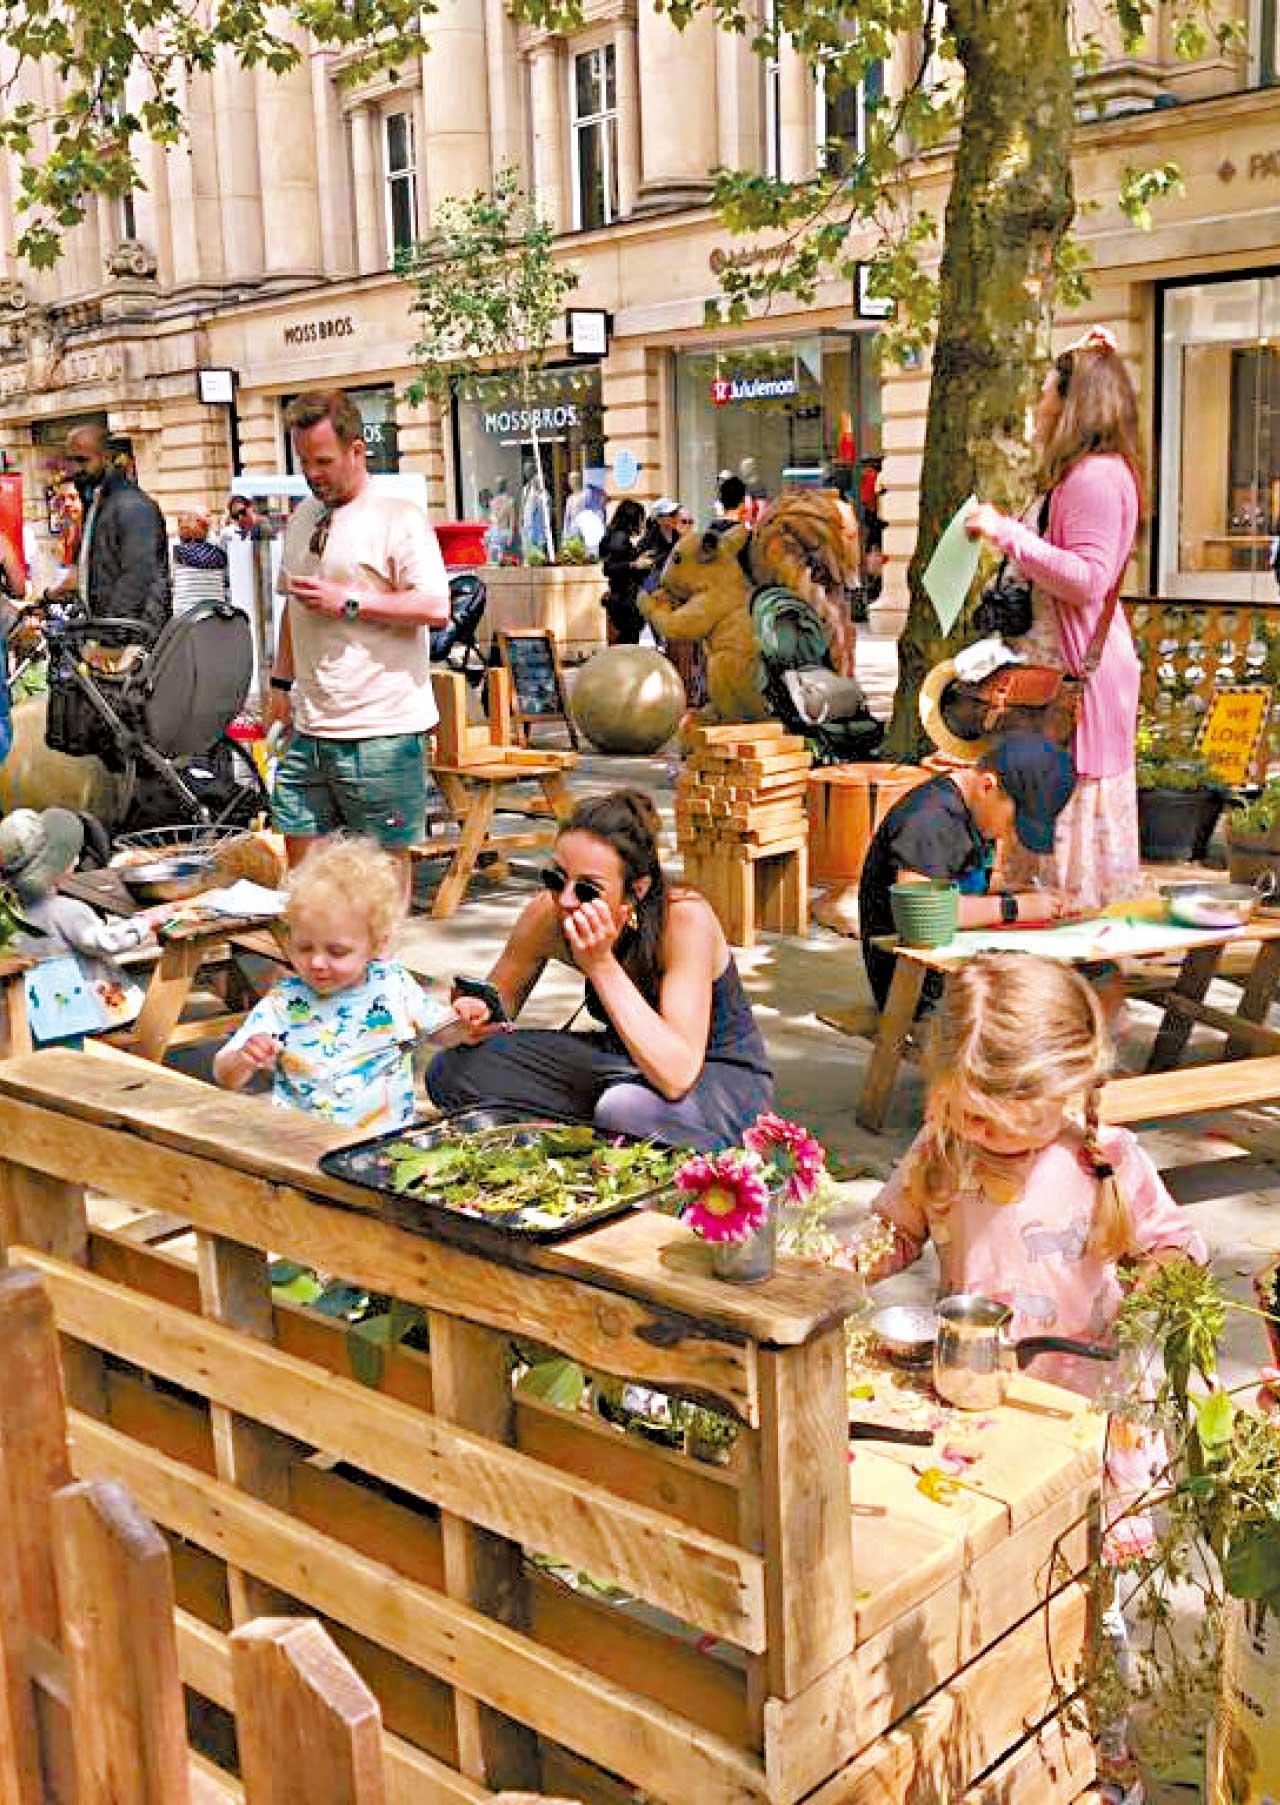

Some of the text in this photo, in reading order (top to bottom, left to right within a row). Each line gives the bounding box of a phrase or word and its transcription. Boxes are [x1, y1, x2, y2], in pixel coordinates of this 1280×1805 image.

[1249, 150, 1280, 179] PA
[284, 322, 317, 345] MOSS
[363, 423, 386, 443] OS.
[485, 410, 528, 433] MOSS
[1210, 727, 1252, 746] LOVE
